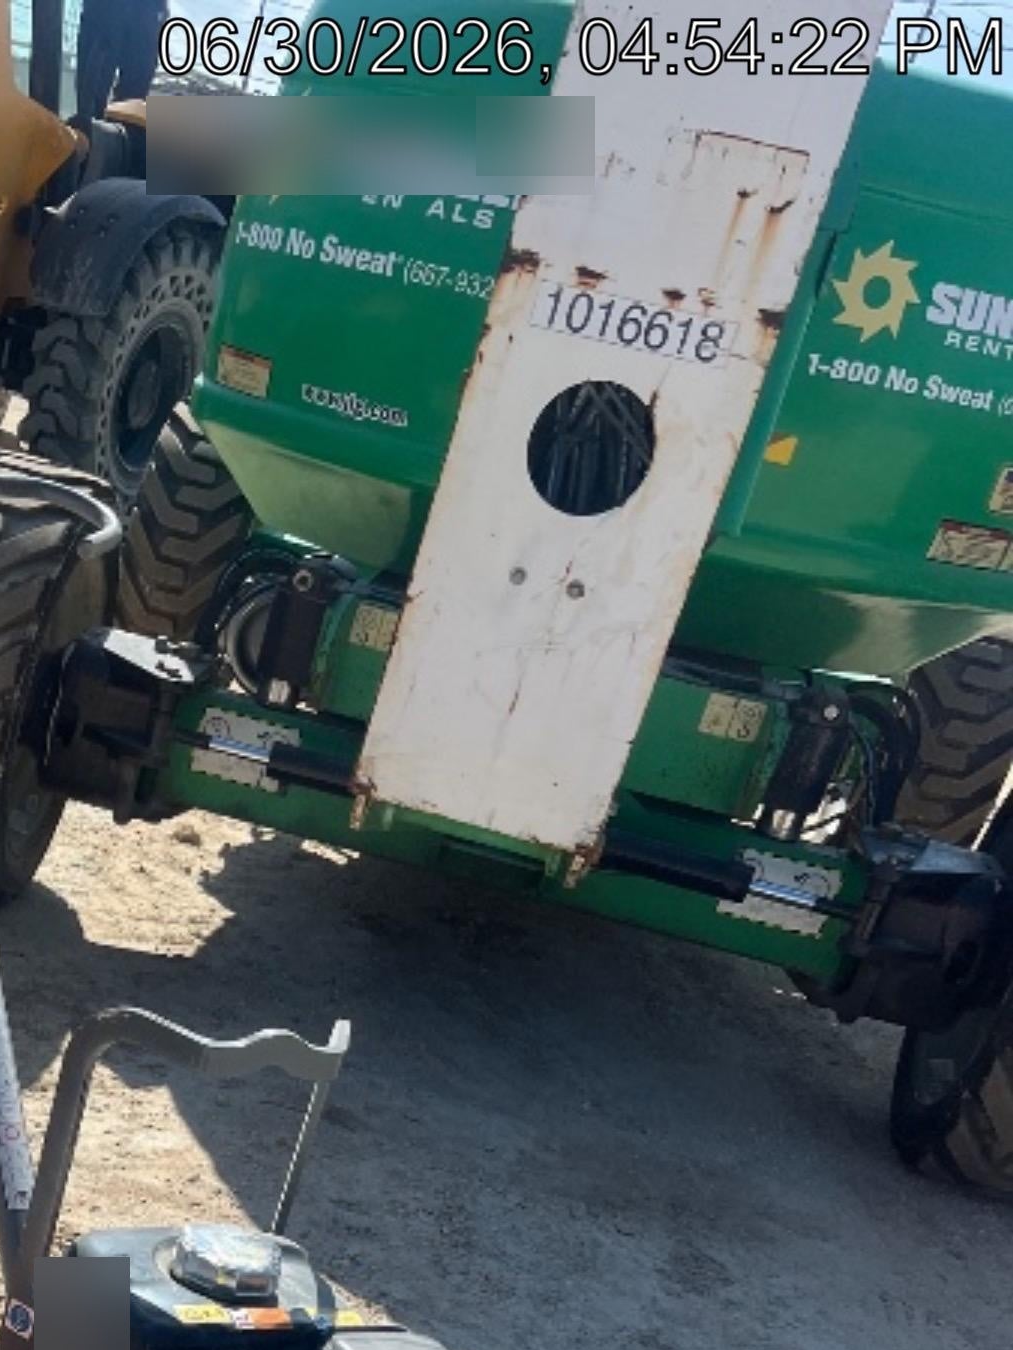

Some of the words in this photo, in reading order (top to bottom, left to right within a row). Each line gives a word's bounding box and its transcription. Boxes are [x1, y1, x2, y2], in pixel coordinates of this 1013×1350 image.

[284, 227, 315, 259] No
[319, 235, 396, 278] Sweat
[547, 284, 725, 363] 1016618
[808, 353, 882, 386] 1-800
[884, 365, 919, 395] No
[923, 374, 994, 412] Sweat
